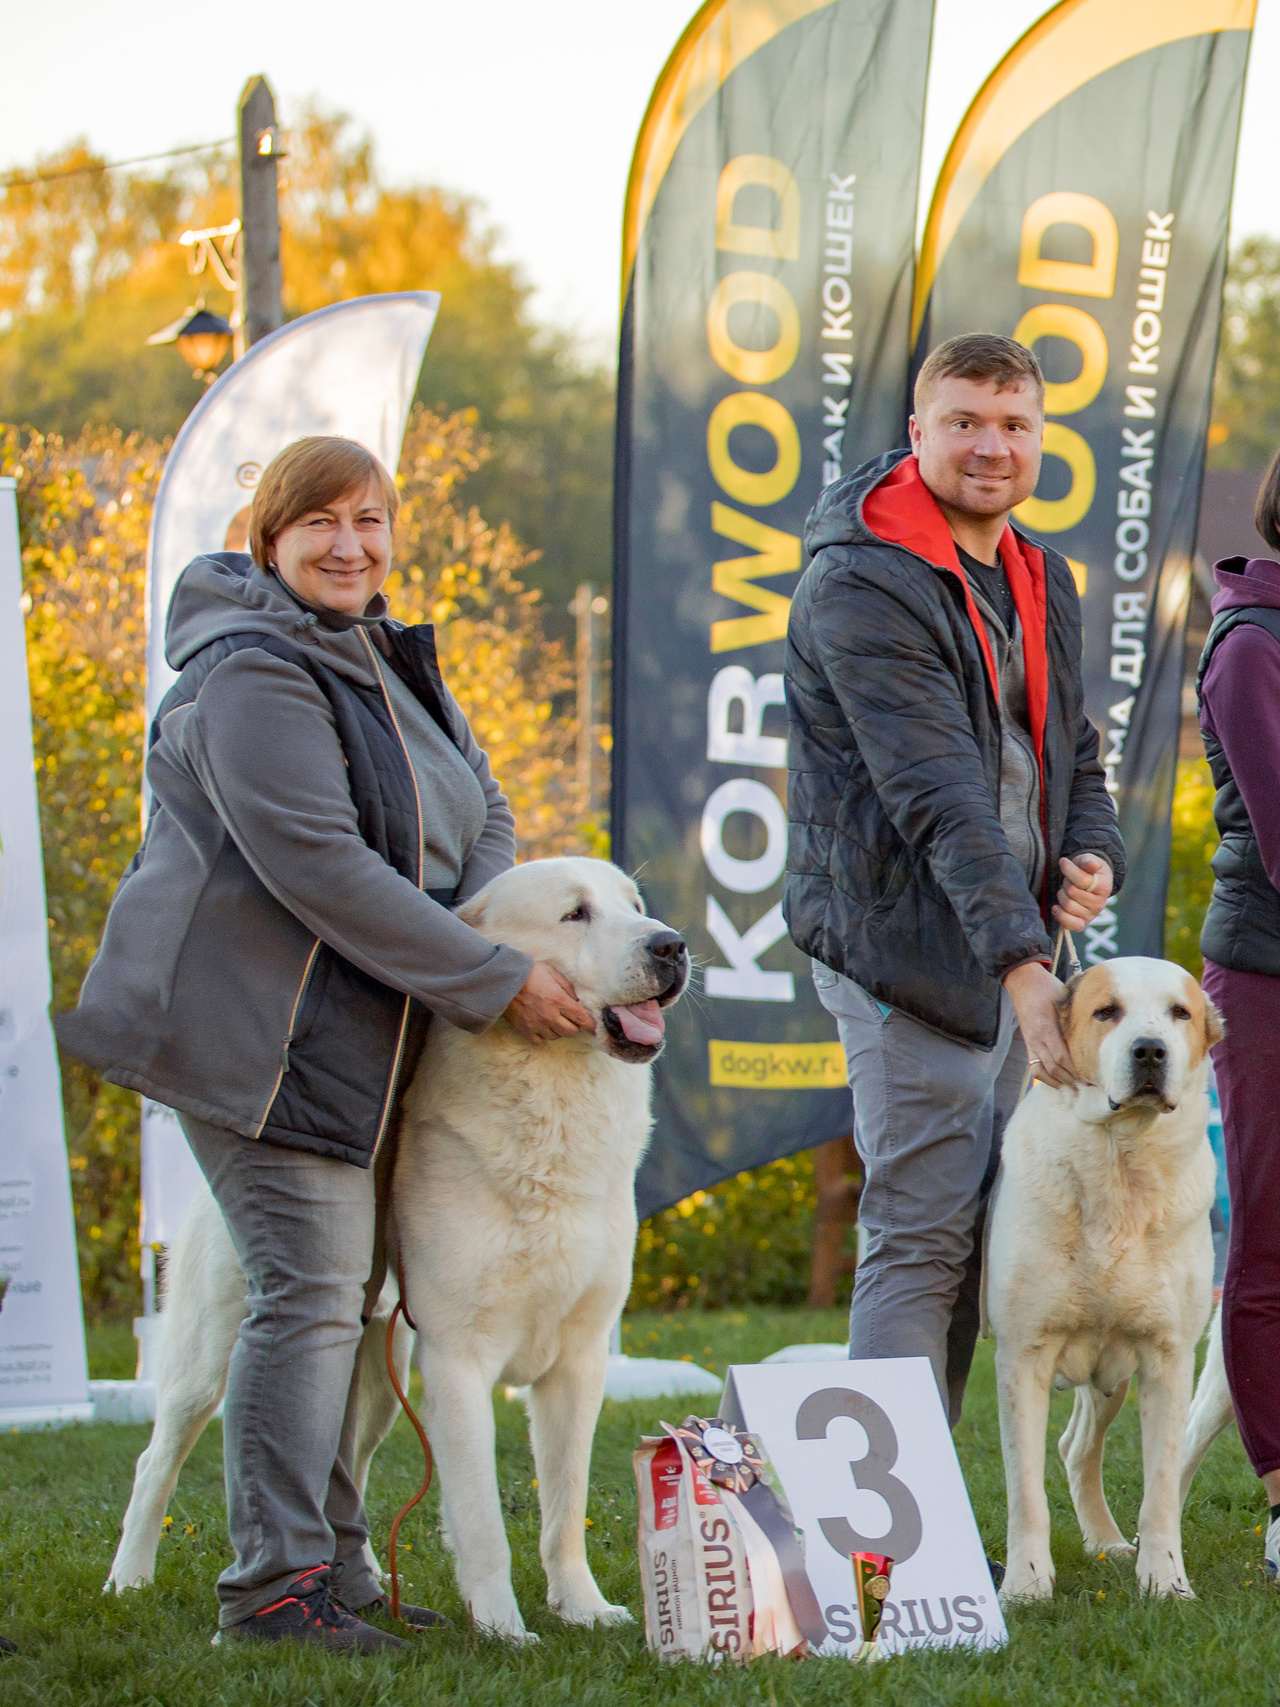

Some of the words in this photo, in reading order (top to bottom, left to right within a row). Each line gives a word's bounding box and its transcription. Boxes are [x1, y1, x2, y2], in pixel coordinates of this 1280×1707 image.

[821, 172, 857, 341] КОШЕК
[1128, 208, 1175, 375] КОШЕК
[821, 352, 854, 386] И
[1124, 384, 1158, 419] И
[1114, 427, 1156, 582] СОБАК
[1109, 591, 1147, 688] ДЛЯ
[720, 1050, 842, 1081] dogkw.ru
[796, 1386, 922, 1566] 3
[654, 1550, 675, 1646] SIRIUS
[700, 1518, 741, 1654] SIRIUS
[825, 1594, 983, 1643] SRIUS
